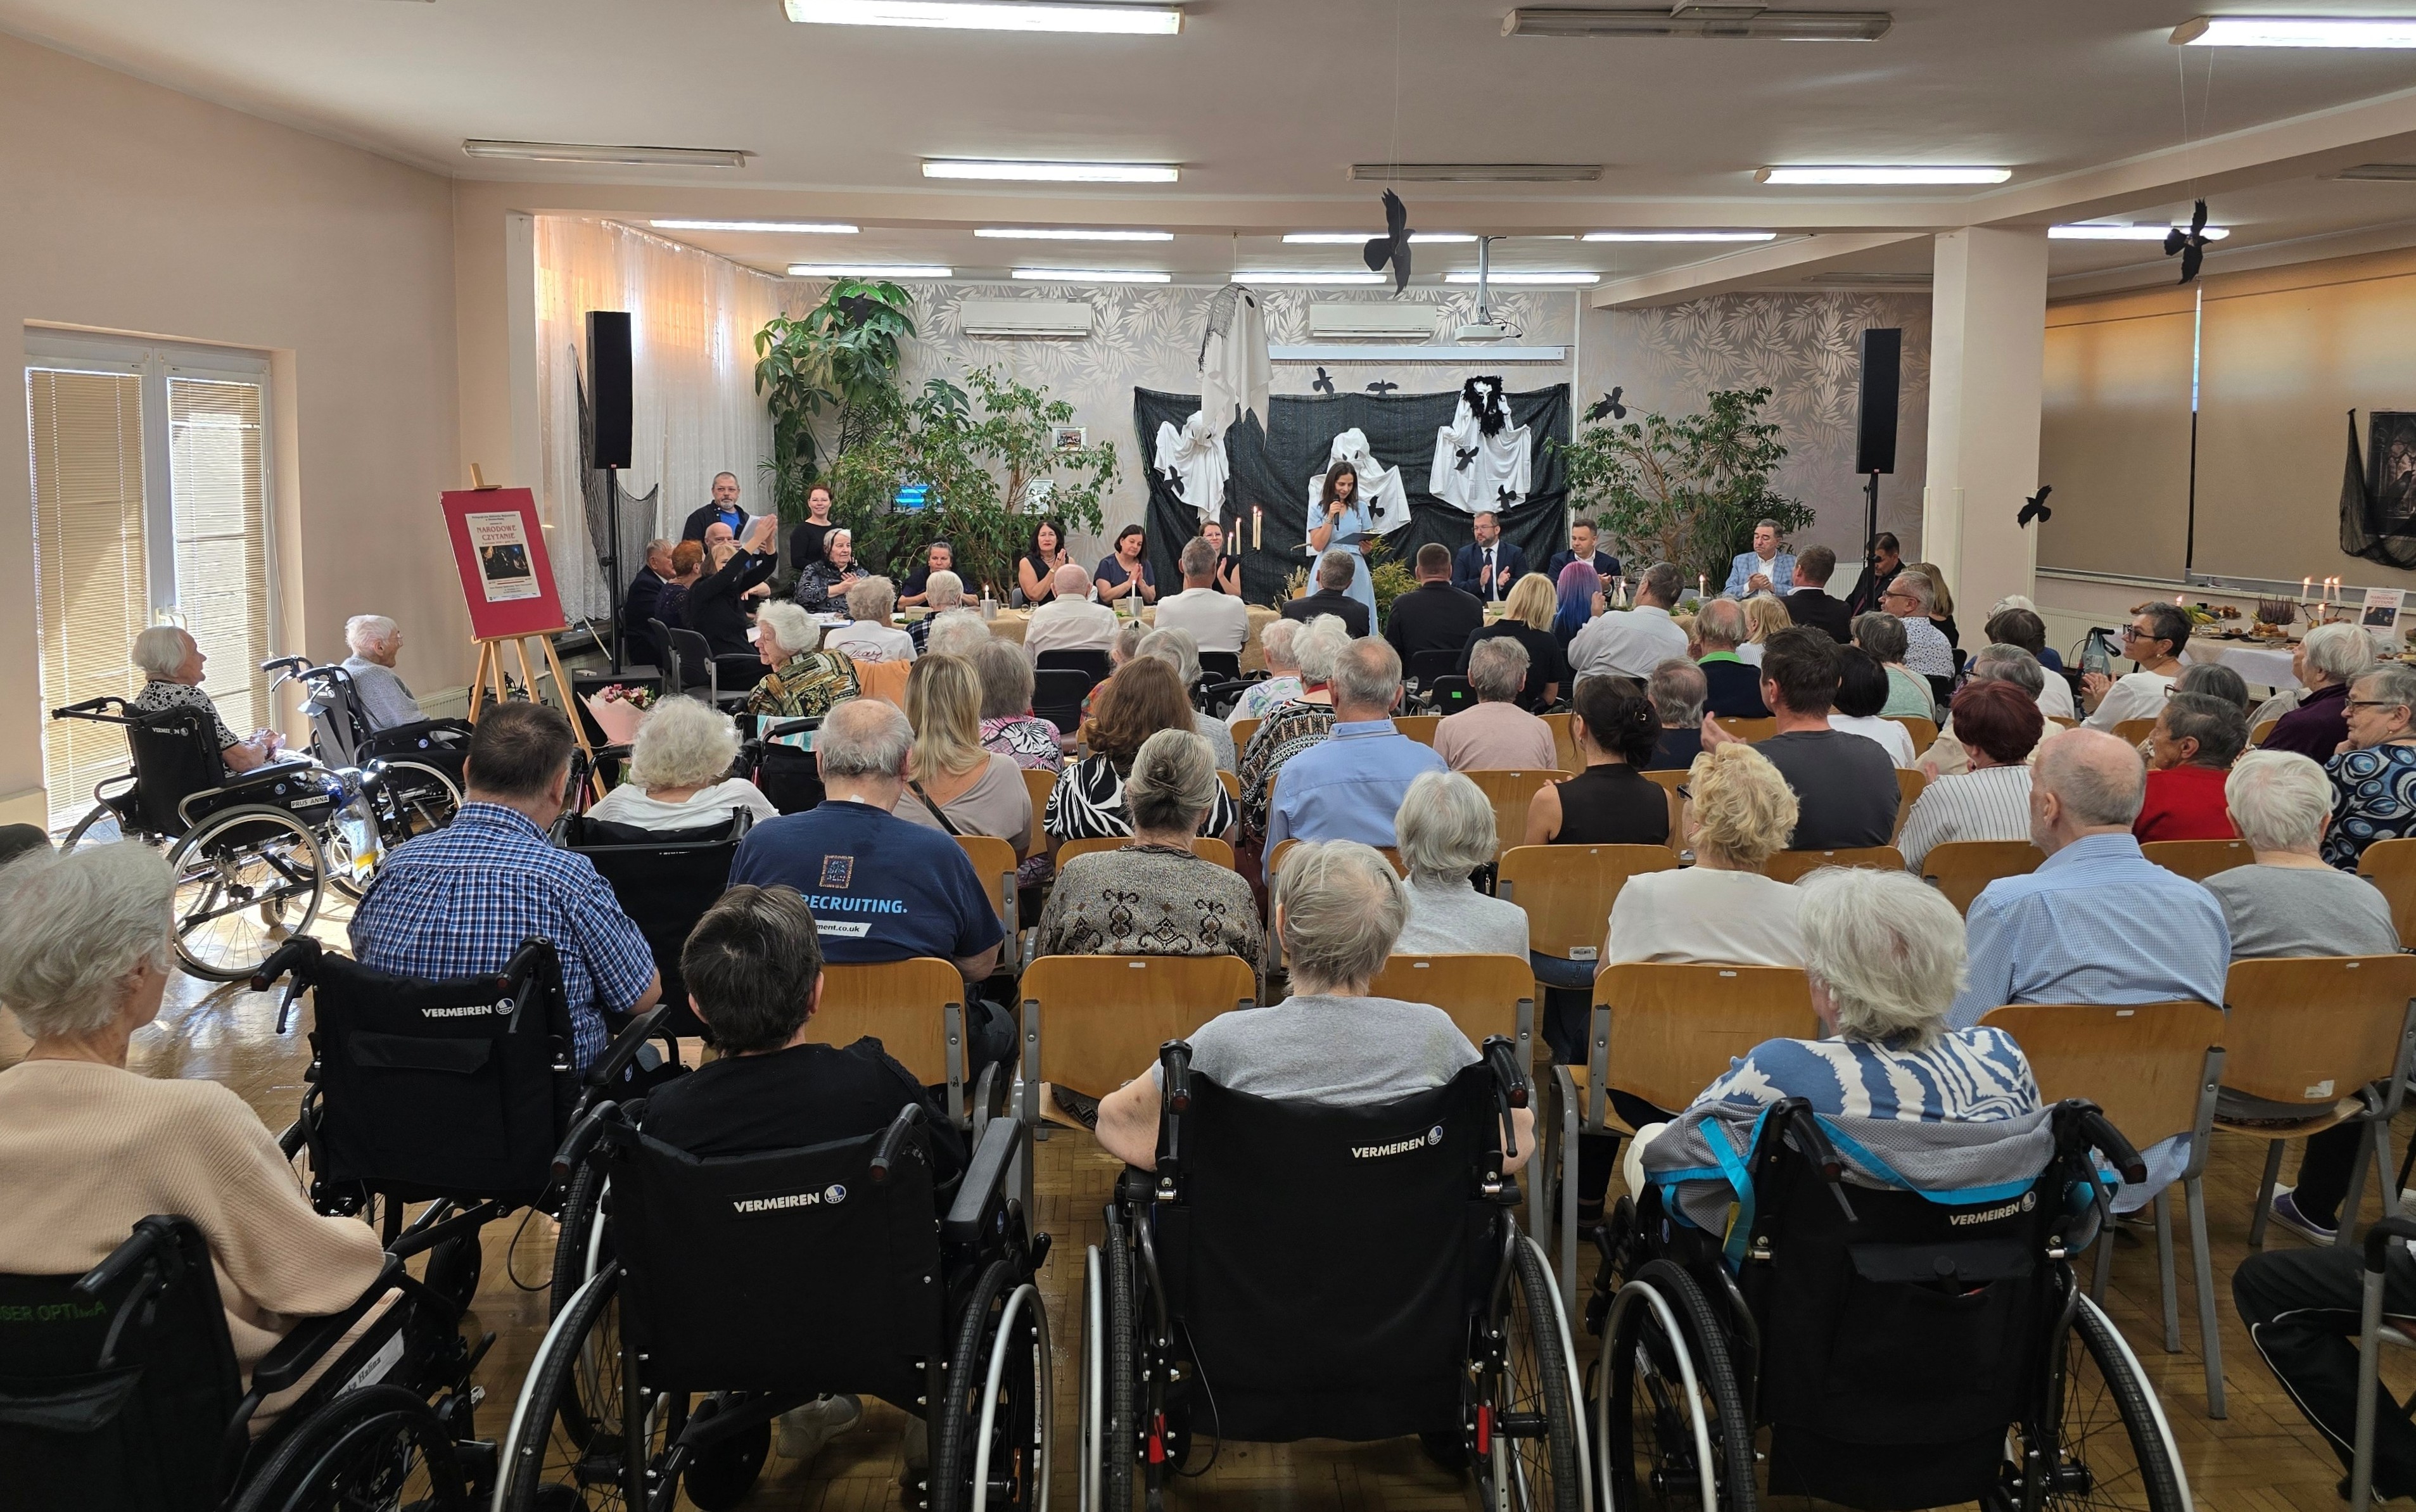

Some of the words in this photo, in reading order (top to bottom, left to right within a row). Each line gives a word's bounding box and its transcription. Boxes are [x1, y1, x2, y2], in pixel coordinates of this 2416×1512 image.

[476, 524, 517, 533] NARODOWE
[421, 1005, 492, 1018] VERMEIREN
[1351, 1136, 1425, 1159] VERMEIREN
[733, 1192, 820, 1213] VERMEIREN
[1949, 1201, 2020, 1226] VERMEIREN
[358, 1356, 381, 1383] Halina
